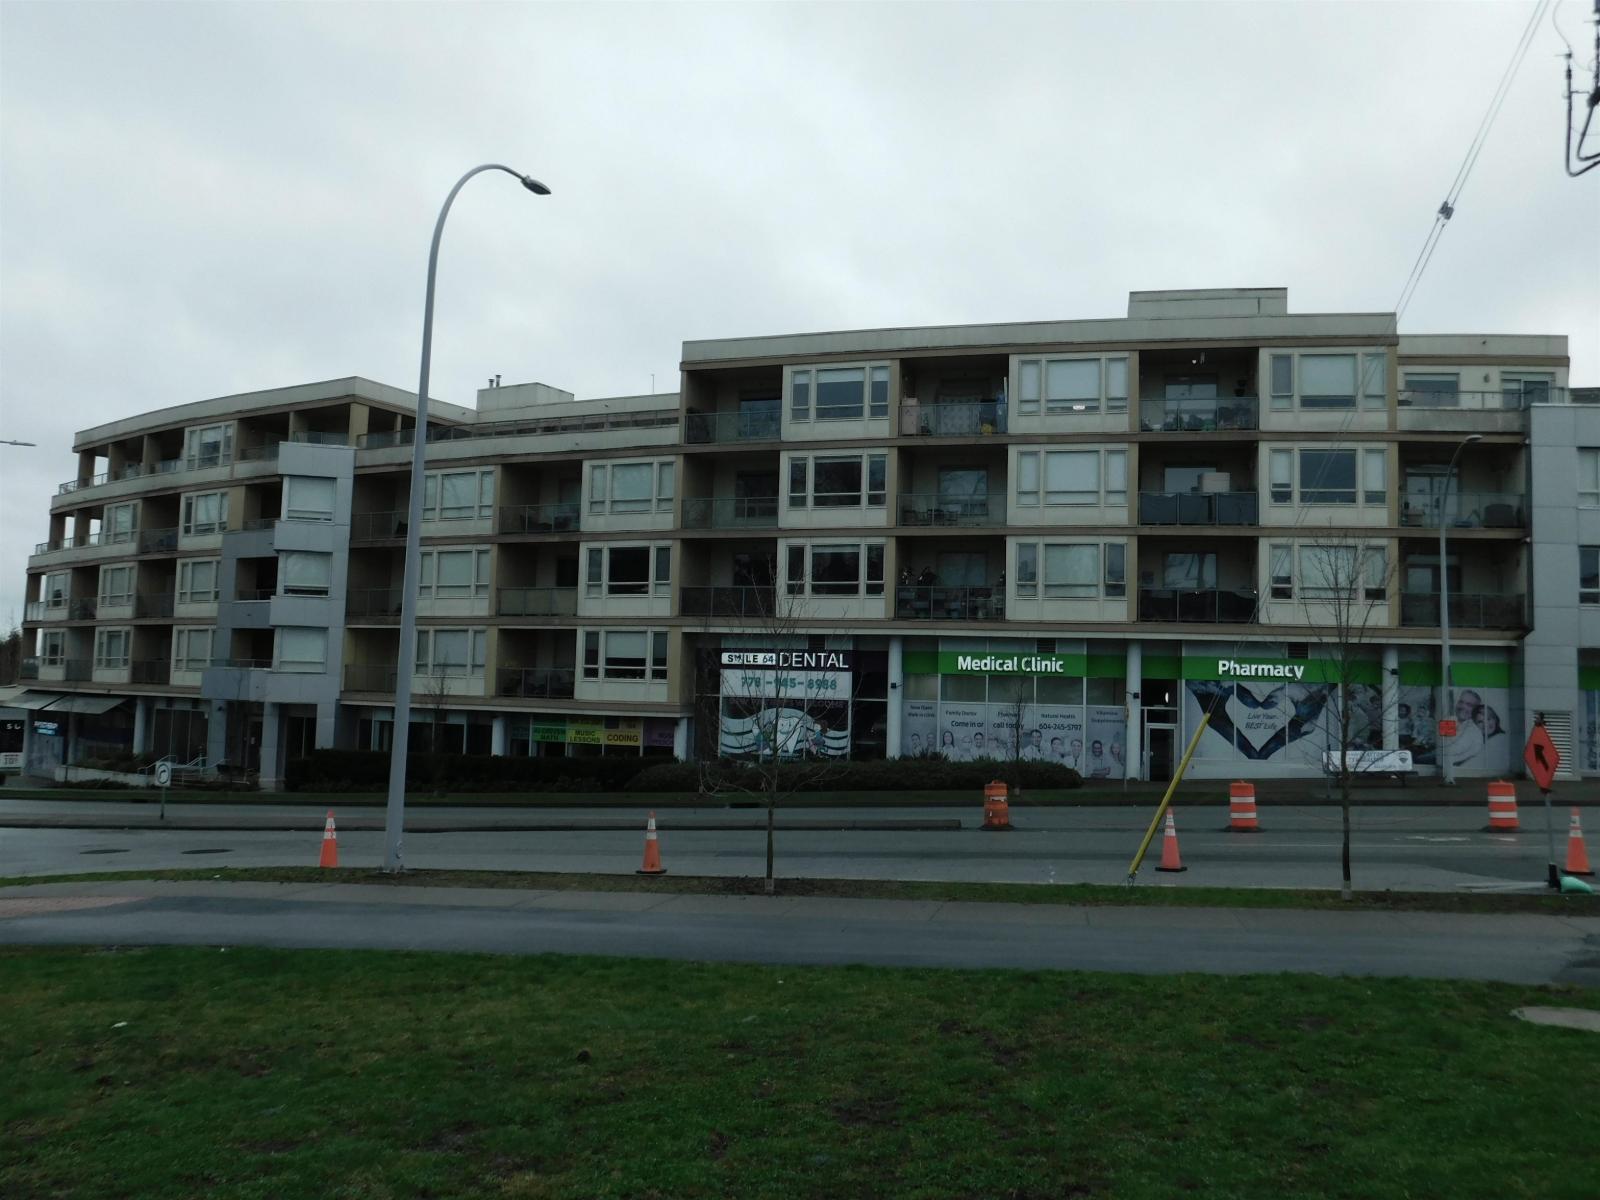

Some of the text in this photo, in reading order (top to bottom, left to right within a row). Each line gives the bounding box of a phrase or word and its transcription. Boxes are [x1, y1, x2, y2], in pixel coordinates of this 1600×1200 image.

[727, 654, 774, 663] SMLE 64
[779, 652, 849, 668] DENTAL
[957, 655, 1064, 672] Medical Clinic
[1218, 660, 1305, 681] Pharmacy
[951, 720, 969, 728] Come
[1005, 722, 1024, 731] tody
[606, 733, 640, 743] CODING
